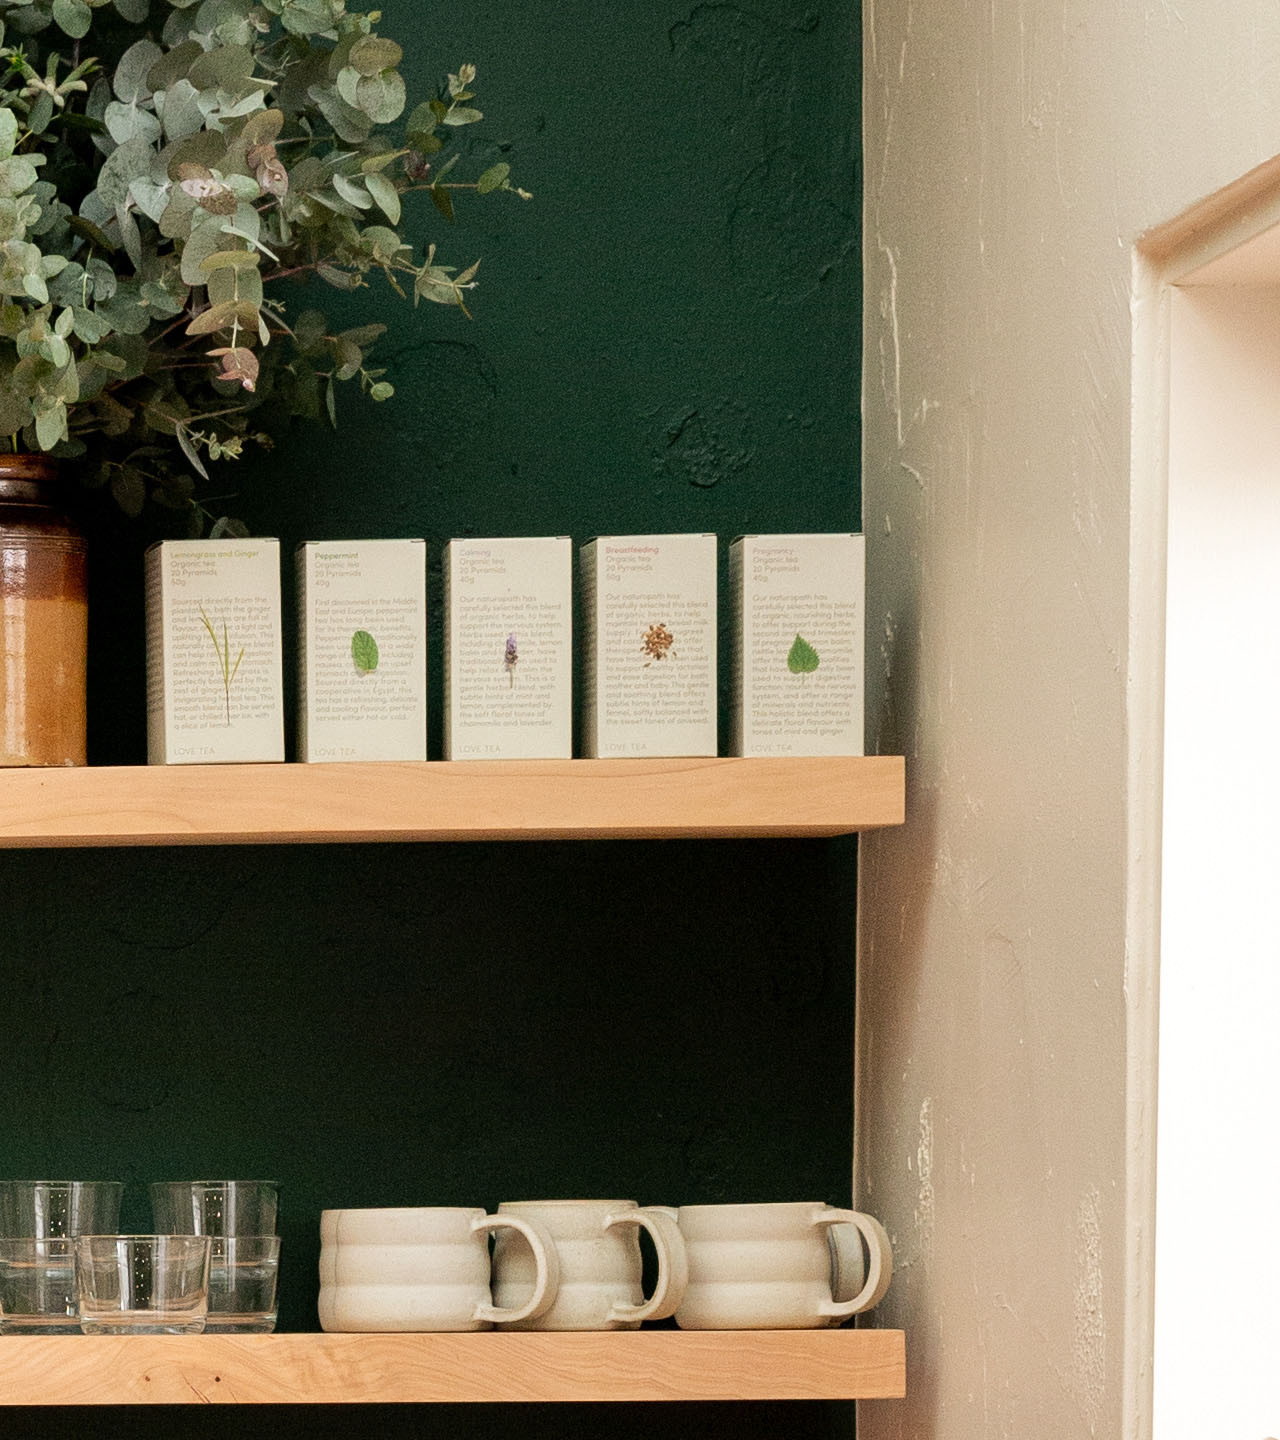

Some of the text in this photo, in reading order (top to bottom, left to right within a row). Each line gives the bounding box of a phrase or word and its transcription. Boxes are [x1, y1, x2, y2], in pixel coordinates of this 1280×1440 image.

[171, 552, 216, 560] Lemongrass
[234, 550, 259, 559] Ginger
[315, 552, 359, 561] Peppermint
[170, 561, 201, 569] Organic
[315, 561, 345, 569] Organic
[459, 558, 490, 567] Organic
[182, 569, 217, 577] Pyramids
